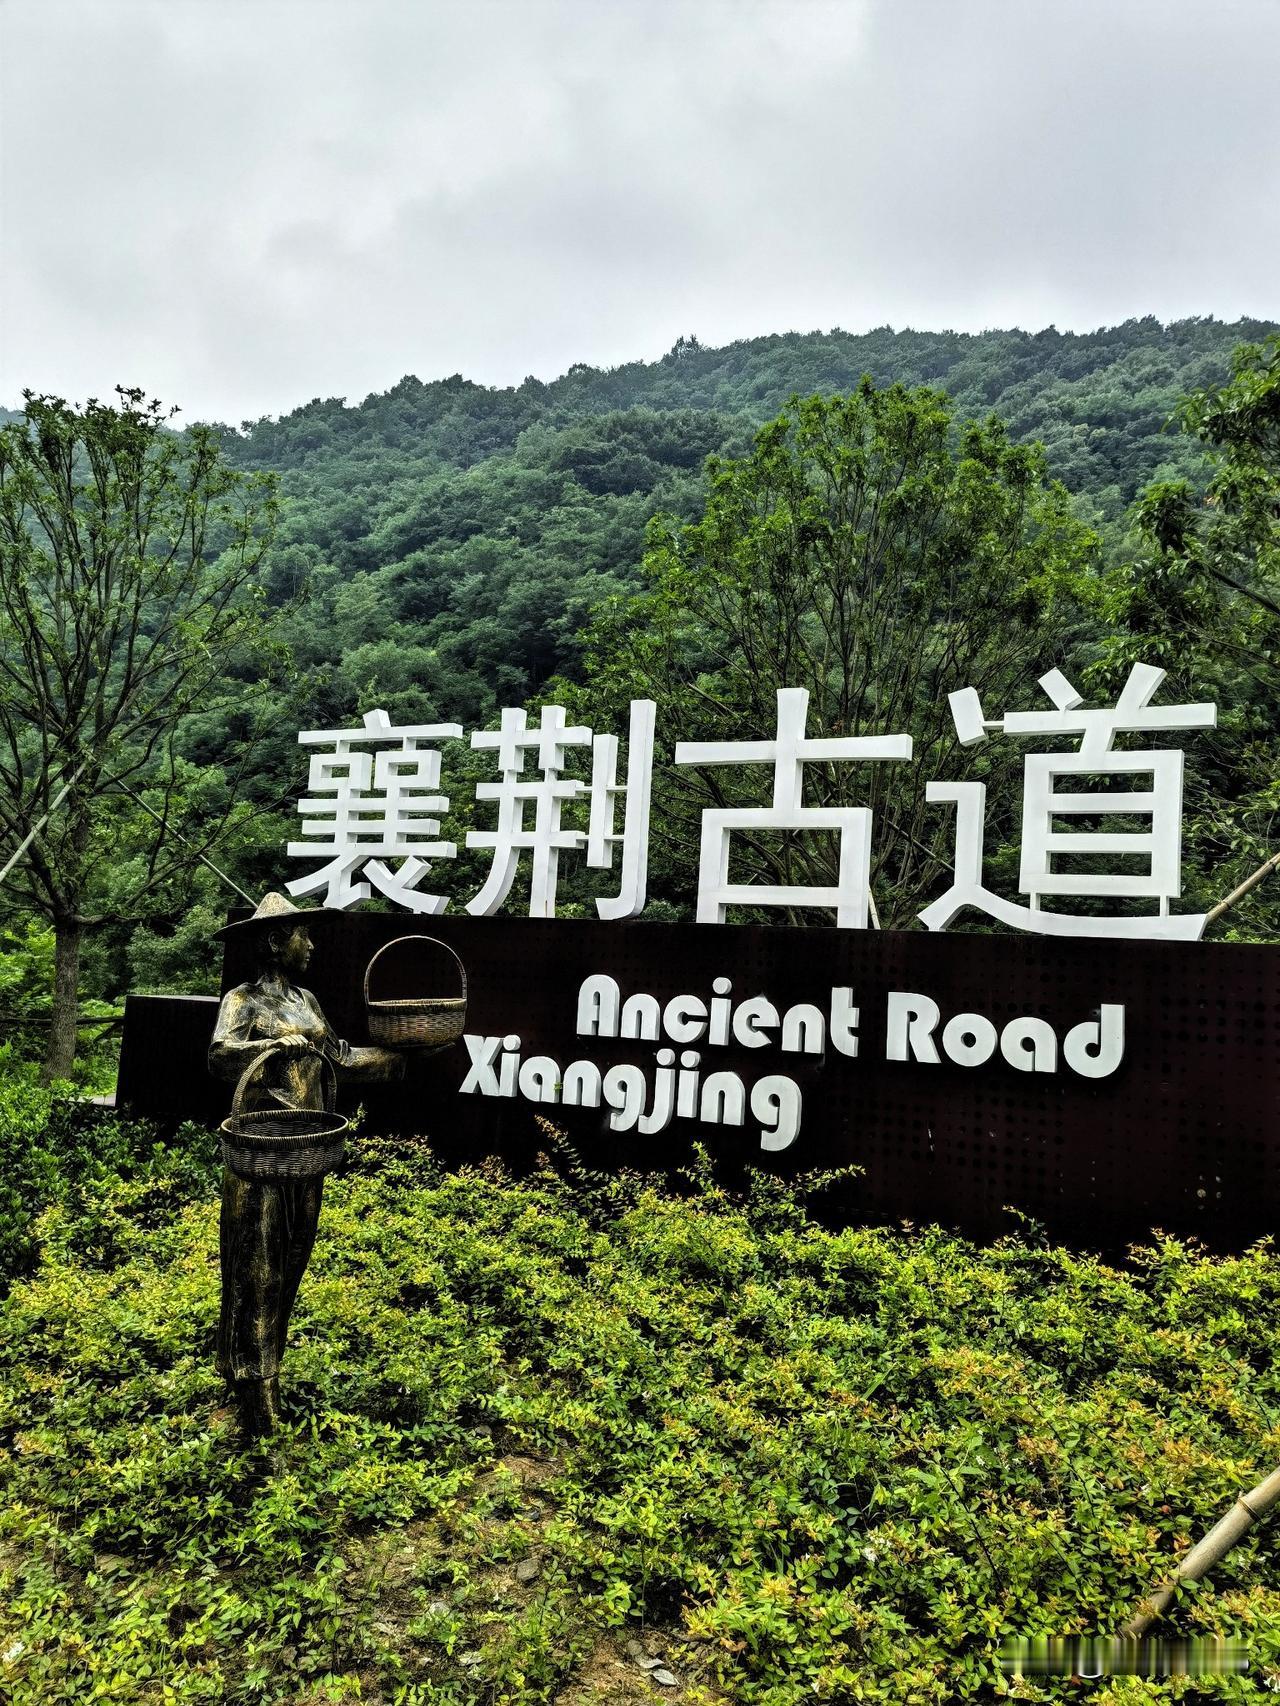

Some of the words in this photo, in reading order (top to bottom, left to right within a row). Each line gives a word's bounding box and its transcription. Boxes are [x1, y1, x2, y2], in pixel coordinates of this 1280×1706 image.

[285, 662, 1217, 941] 襄荆古道
[576, 974, 859, 1058] Ancient
[886, 992, 1125, 1079] Road
[458, 1034, 803, 1152] Xiangjing
